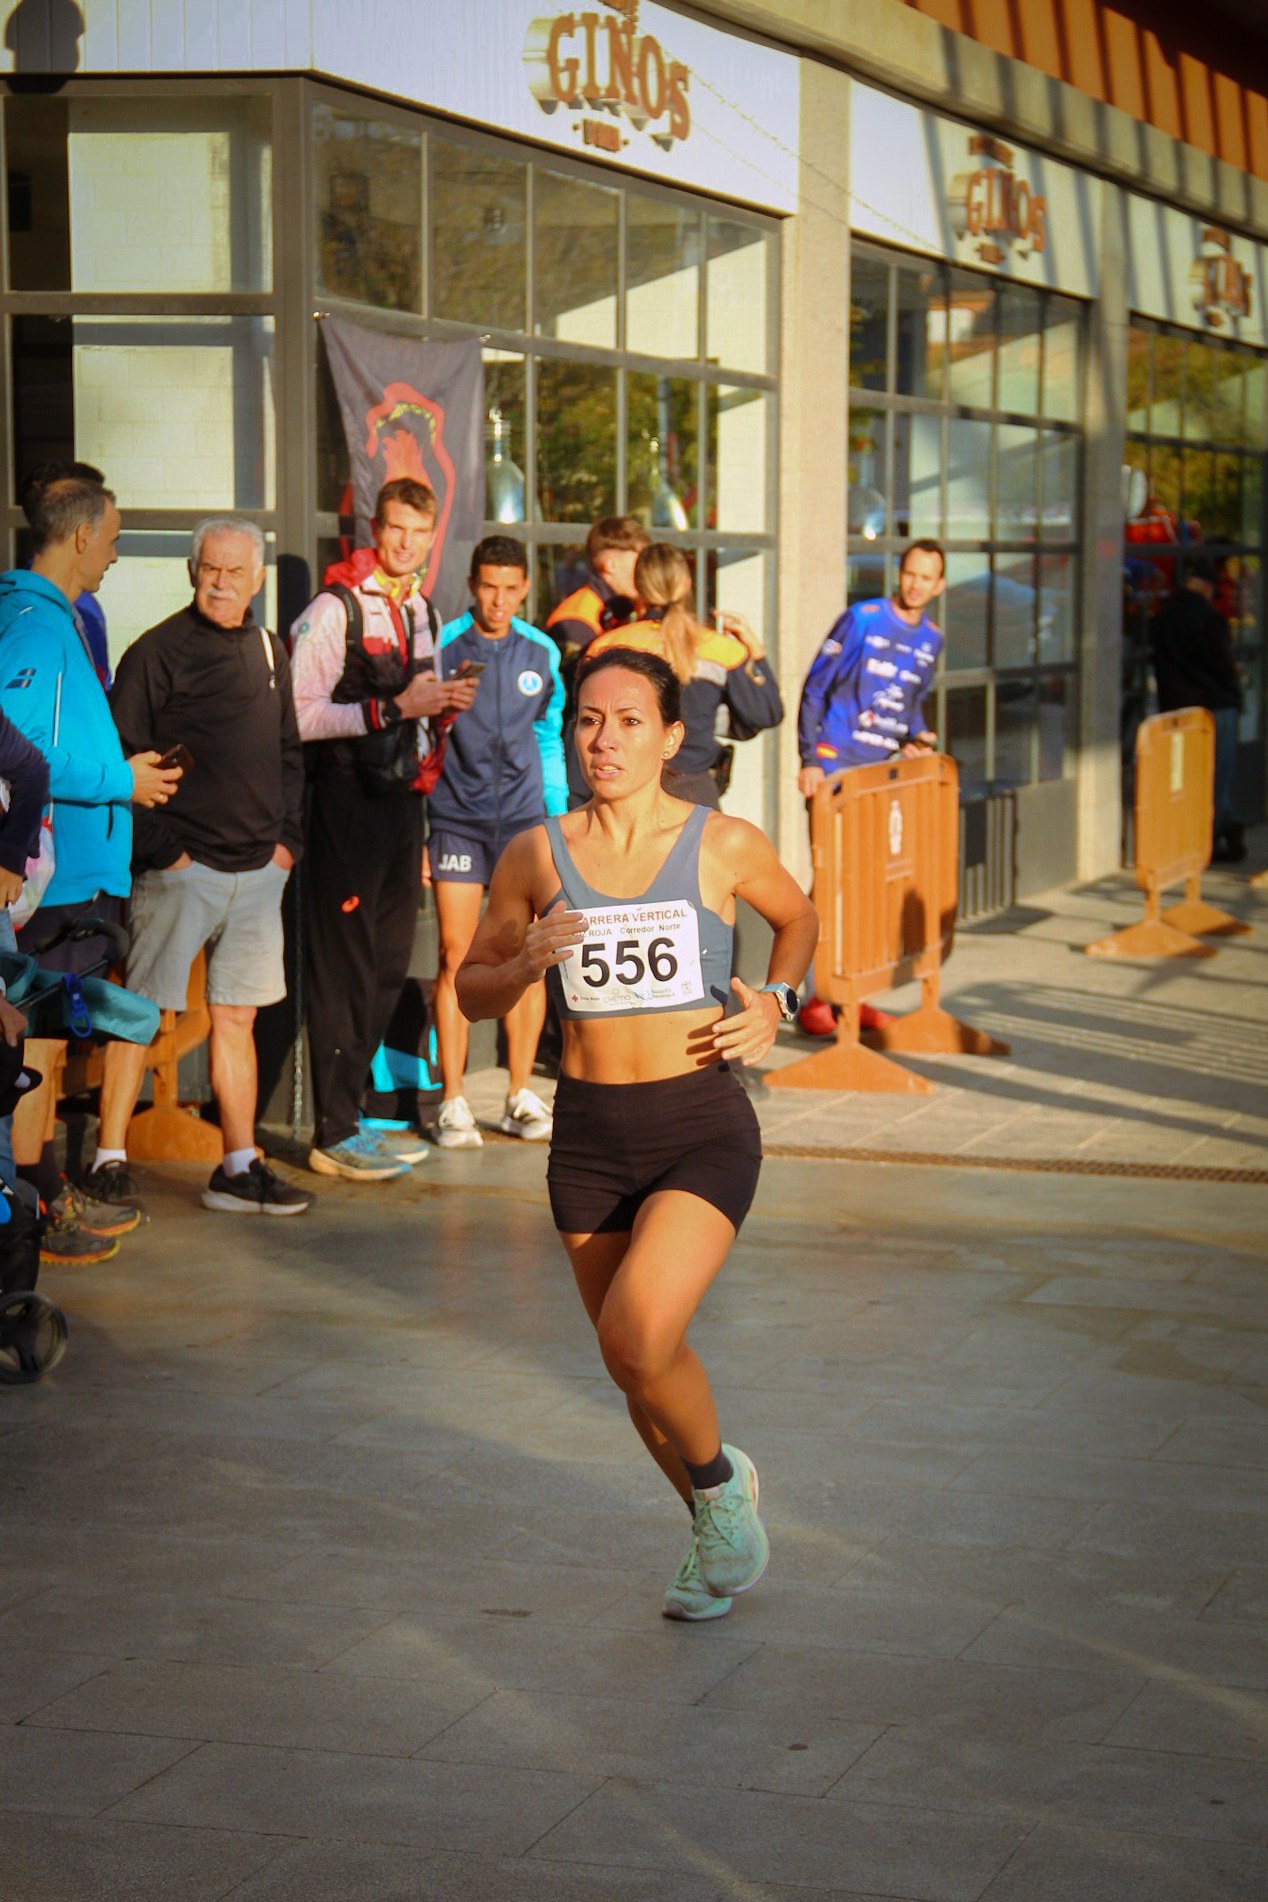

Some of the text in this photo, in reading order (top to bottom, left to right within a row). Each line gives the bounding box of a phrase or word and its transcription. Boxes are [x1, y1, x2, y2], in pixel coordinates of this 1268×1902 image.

[547, 12, 691, 141] GINOS
[438, 854, 472, 872] JAB
[631, 909, 688, 922] VERTICAL
[588, 929, 612, 937] ROJA
[620, 926, 655, 935] Corredor
[658, 923, 681, 932] Norte
[581, 937, 678, 988] 556
